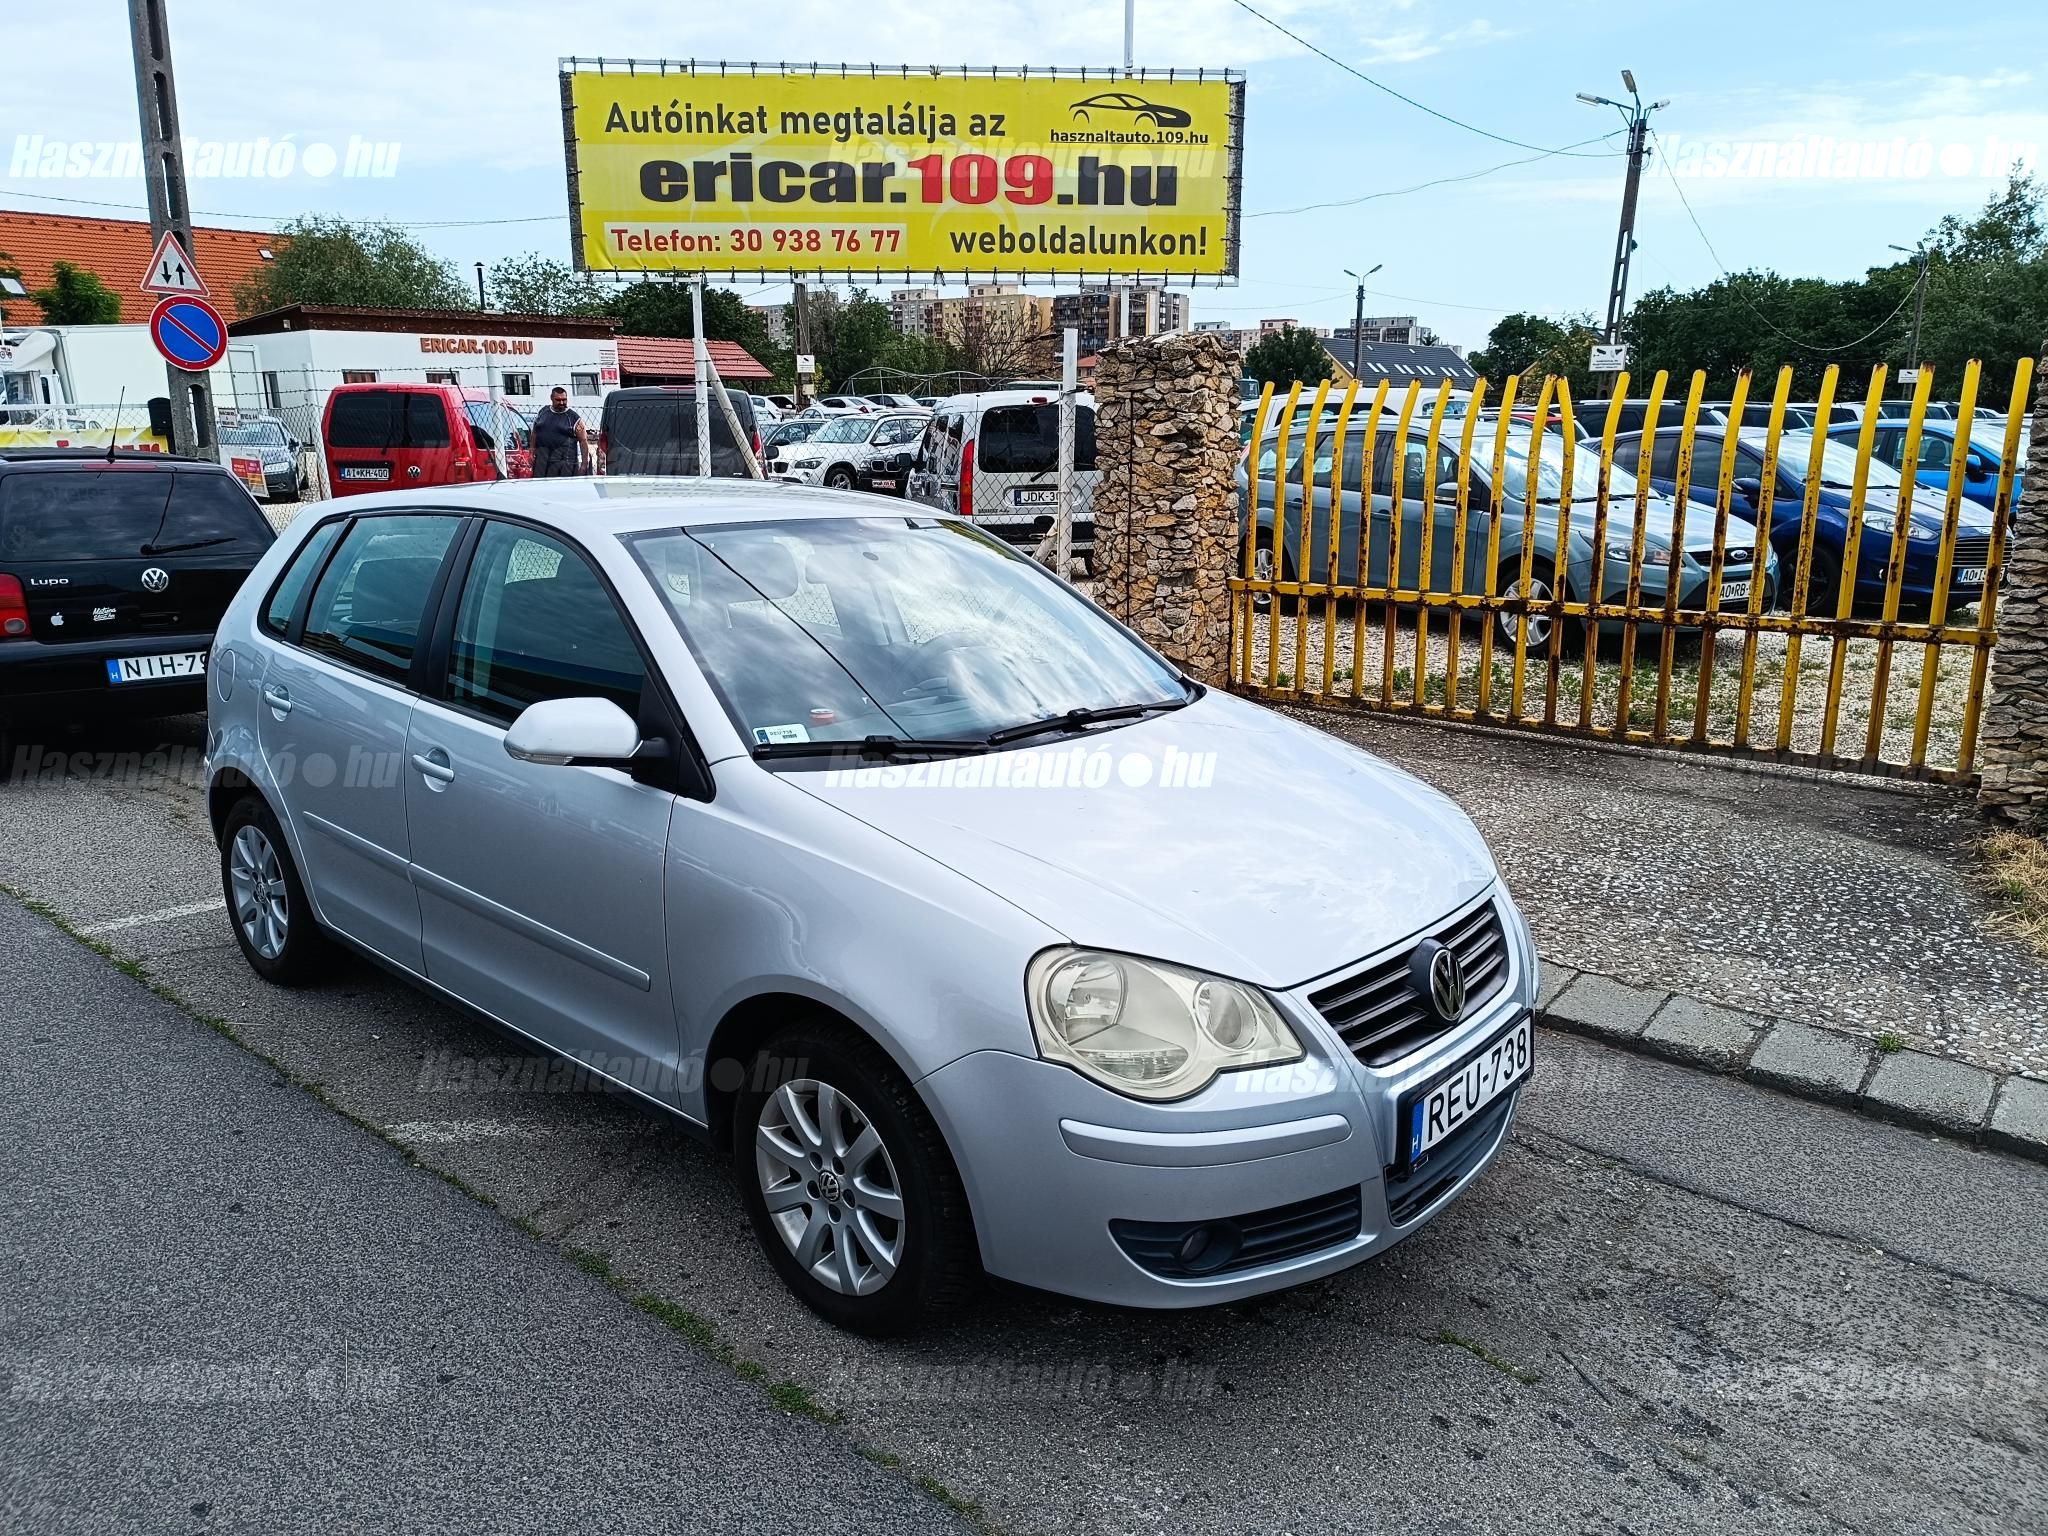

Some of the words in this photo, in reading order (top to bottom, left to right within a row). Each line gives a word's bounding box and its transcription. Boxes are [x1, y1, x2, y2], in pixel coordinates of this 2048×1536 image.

[604, 98, 769, 135] Autóinkat
[780, 100, 956, 144] megtalálja
[968, 113, 1006, 137] az
[1050, 129, 1209, 144] hasznaltauto.109.hu
[639, 152, 1178, 206] ericar.109.hu
[610, 228, 721, 252] Telefon:
[729, 228, 763, 252] 30
[772, 229, 822, 252] 938
[831, 229, 861, 253] 76
[870, 229, 901, 253] 77
[949, 224, 1207, 256] weboldalunkon!
[419, 337, 534, 355] ERICAR.109.HU
[30, 577, 69, 587] Lupo
[1427, 1027, 1528, 1143] REU-738
